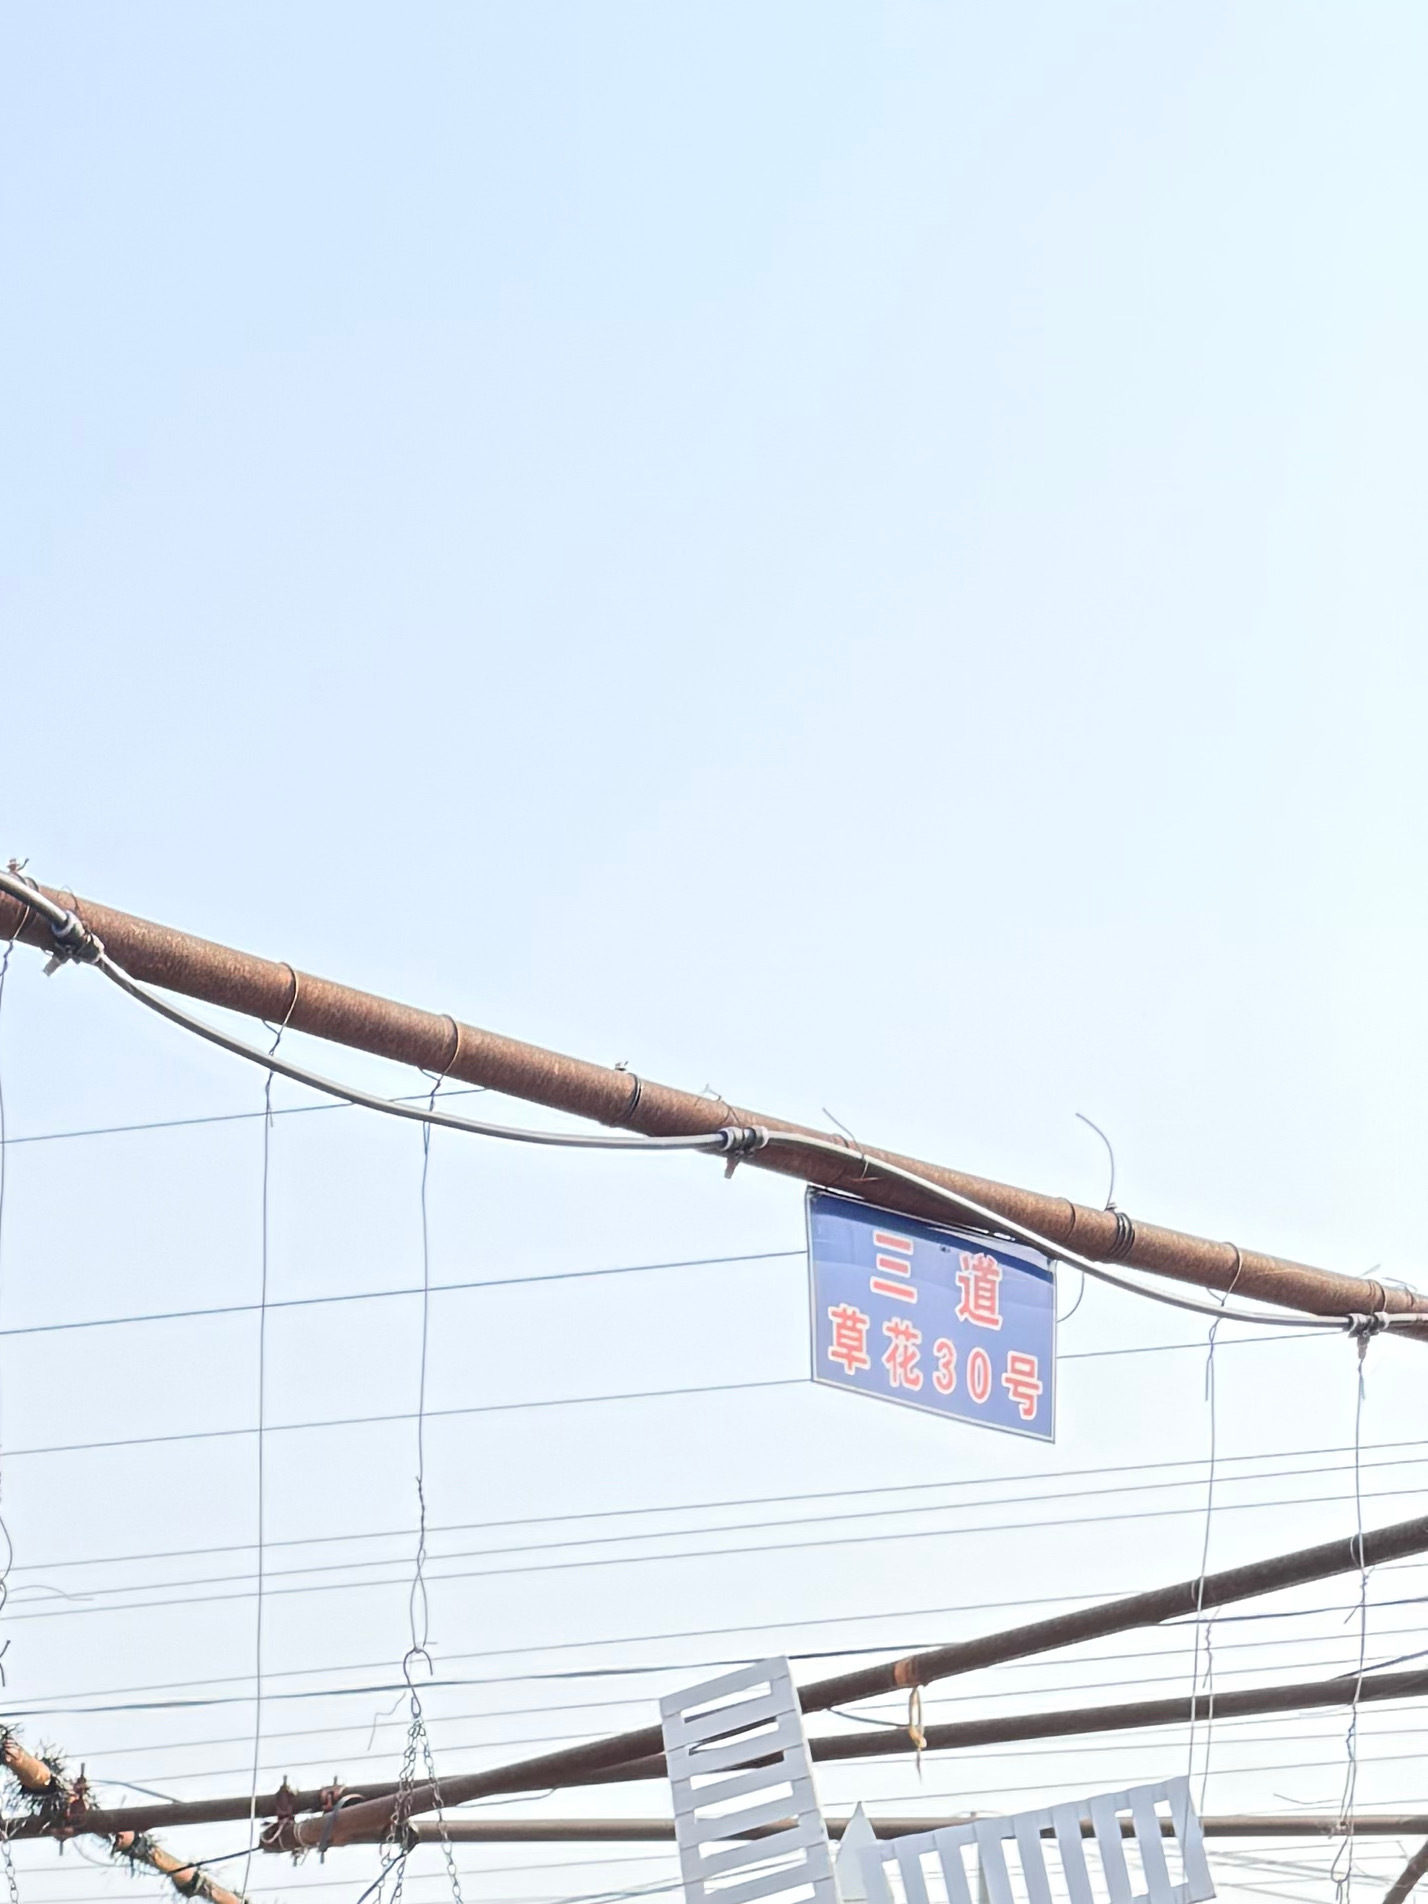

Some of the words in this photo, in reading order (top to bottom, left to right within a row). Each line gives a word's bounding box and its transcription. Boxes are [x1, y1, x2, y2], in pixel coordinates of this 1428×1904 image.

[870, 1231, 1003, 1330] 三道
[828, 1304, 1042, 1420] 草花30号
